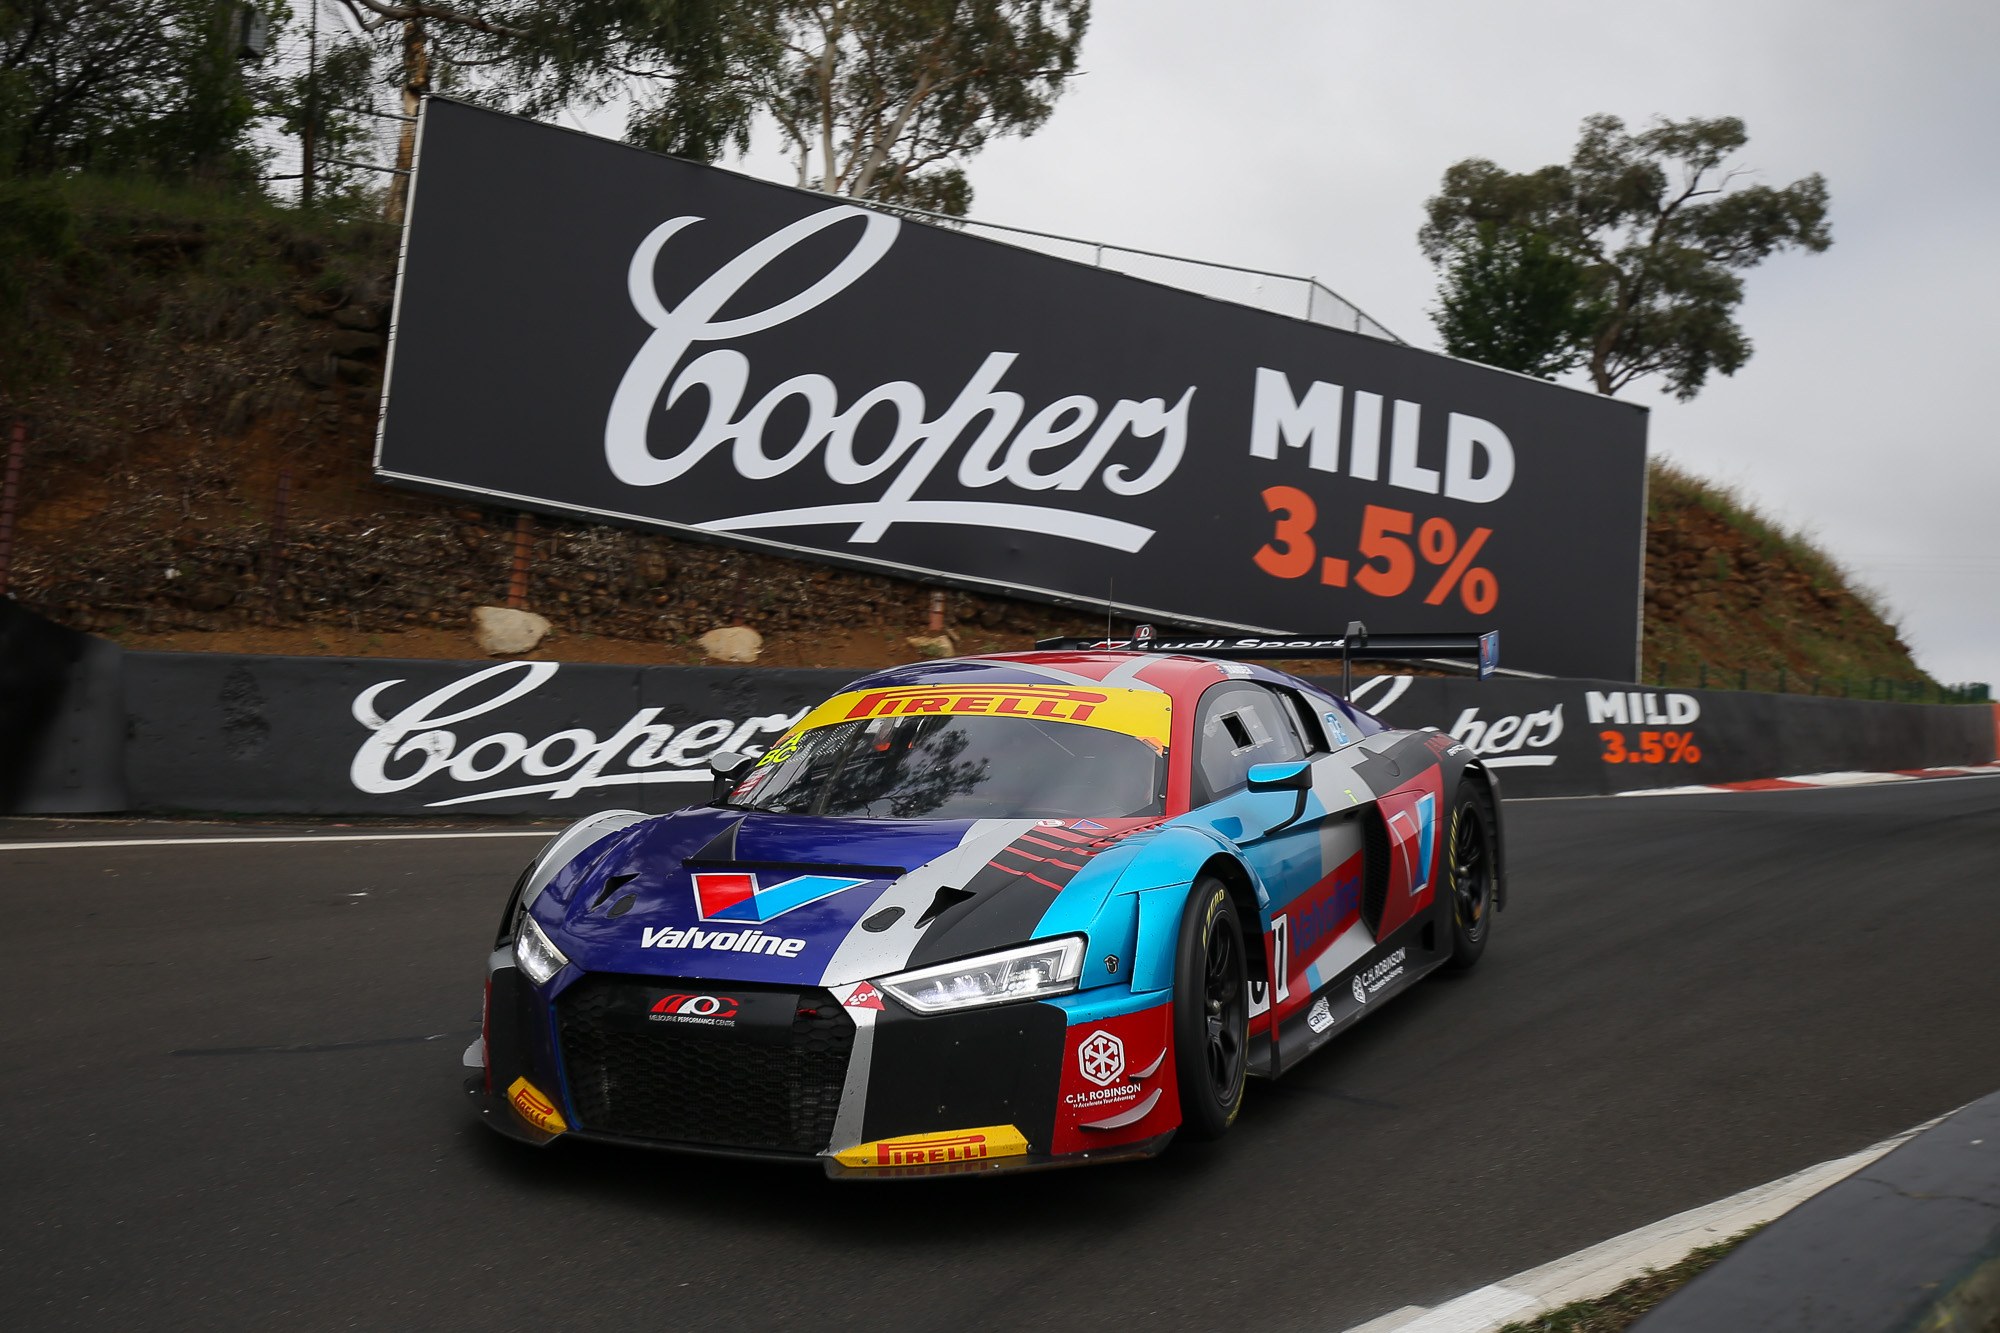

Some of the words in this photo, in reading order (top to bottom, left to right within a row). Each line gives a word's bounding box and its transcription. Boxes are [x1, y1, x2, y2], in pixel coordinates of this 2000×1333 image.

[605, 204, 1197, 548] Coopers
[1250, 367, 1515, 503] MILD
[1253, 486, 1498, 615] 3.5%
[1232, 639, 1345, 648] Sport
[844, 686, 1107, 721] PIRELLI
[1585, 691, 1700, 725] MILD
[1600, 731, 1701, 764] 3.5%
[641, 927, 806, 957] Valvoline
[849, 990, 877, 1006] TOW
[678, 1016, 714, 1026] PERFORMANCE
[1066, 1092, 1088, 1103] C.H.
[1089, 1083, 1141, 1100] ROBINSON
[877, 1135, 987, 1164] PIRELLI
